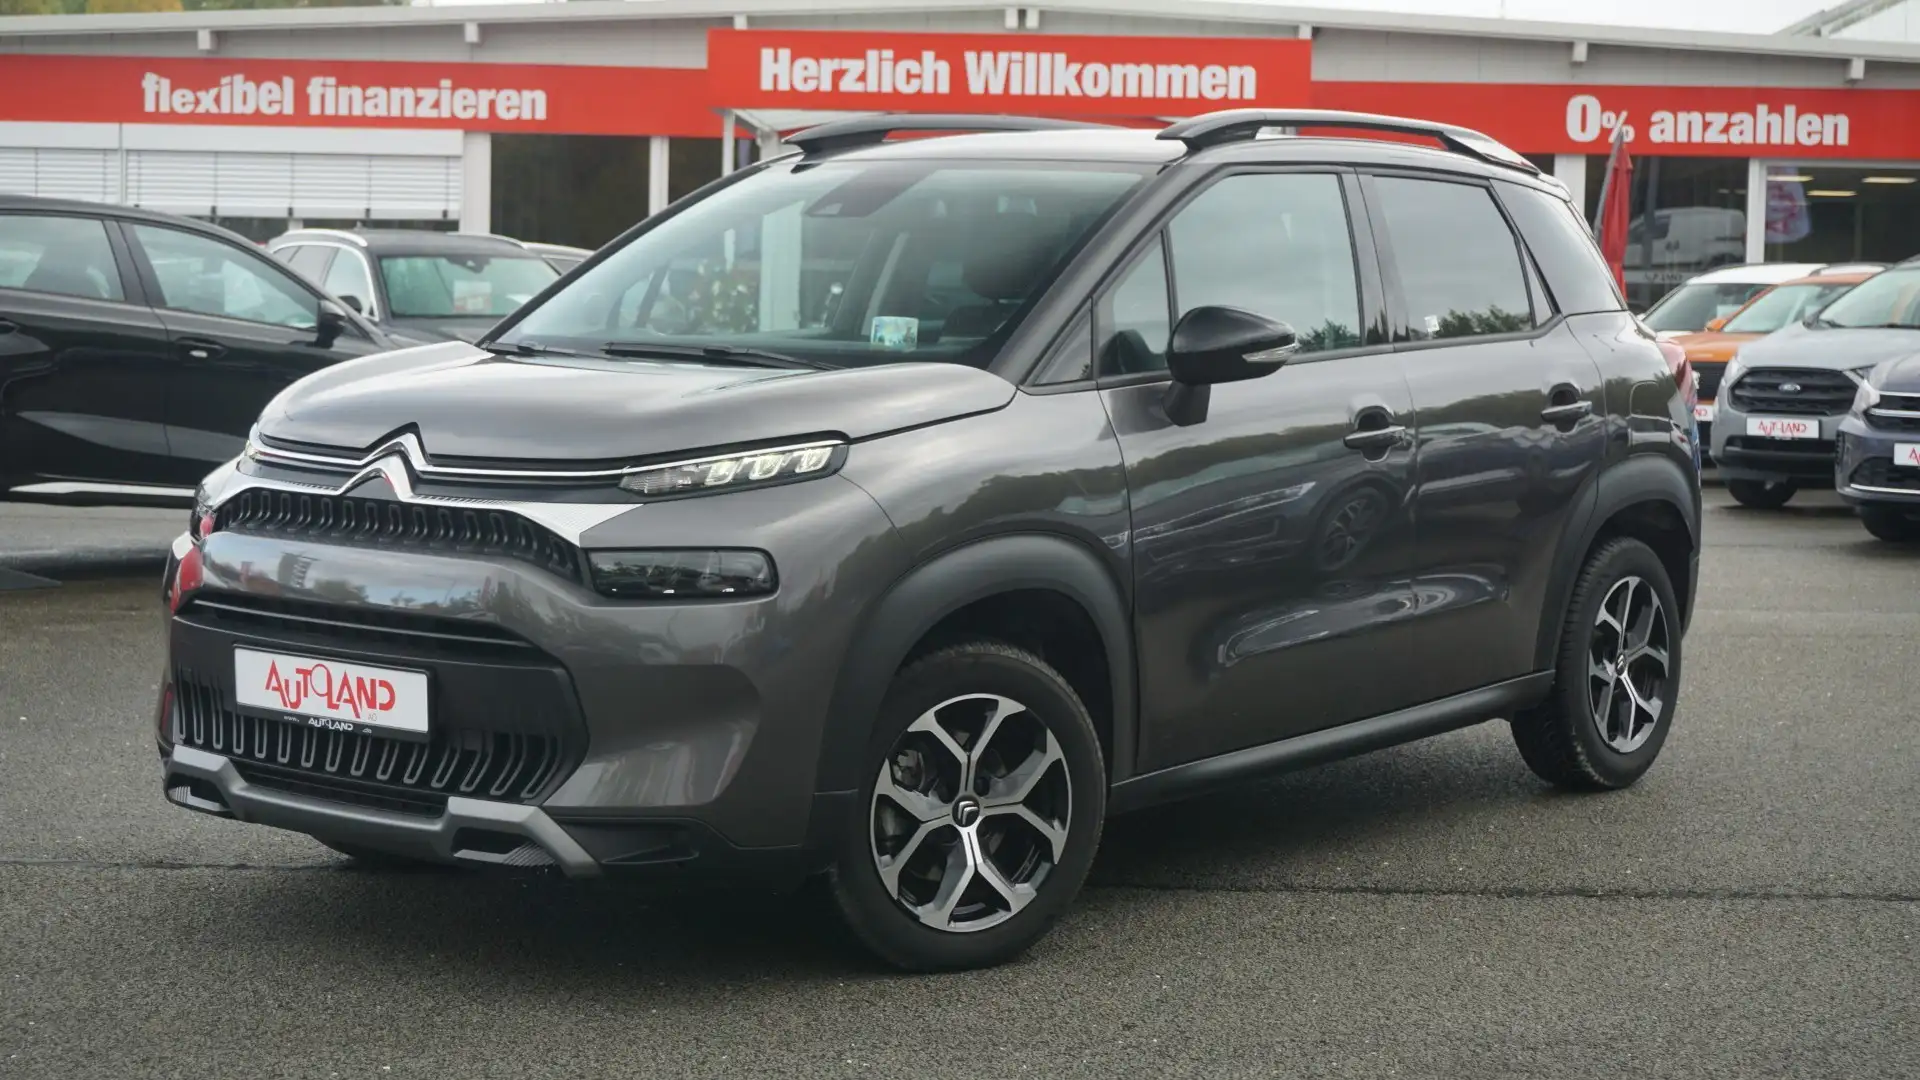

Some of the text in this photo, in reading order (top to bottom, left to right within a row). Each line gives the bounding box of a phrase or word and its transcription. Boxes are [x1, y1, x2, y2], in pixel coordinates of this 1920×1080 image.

[142, 72, 547, 121] flexibel finanzieren
[760, 48, 1257, 101] Herzlich Willkommen
[1566, 94, 1849, 146] 0% anzahlen
[1758, 420, 1807, 437] AUTLAND
[265, 659, 396, 719] AUTOLAND
[308, 717, 354, 731] AUTOLAND
